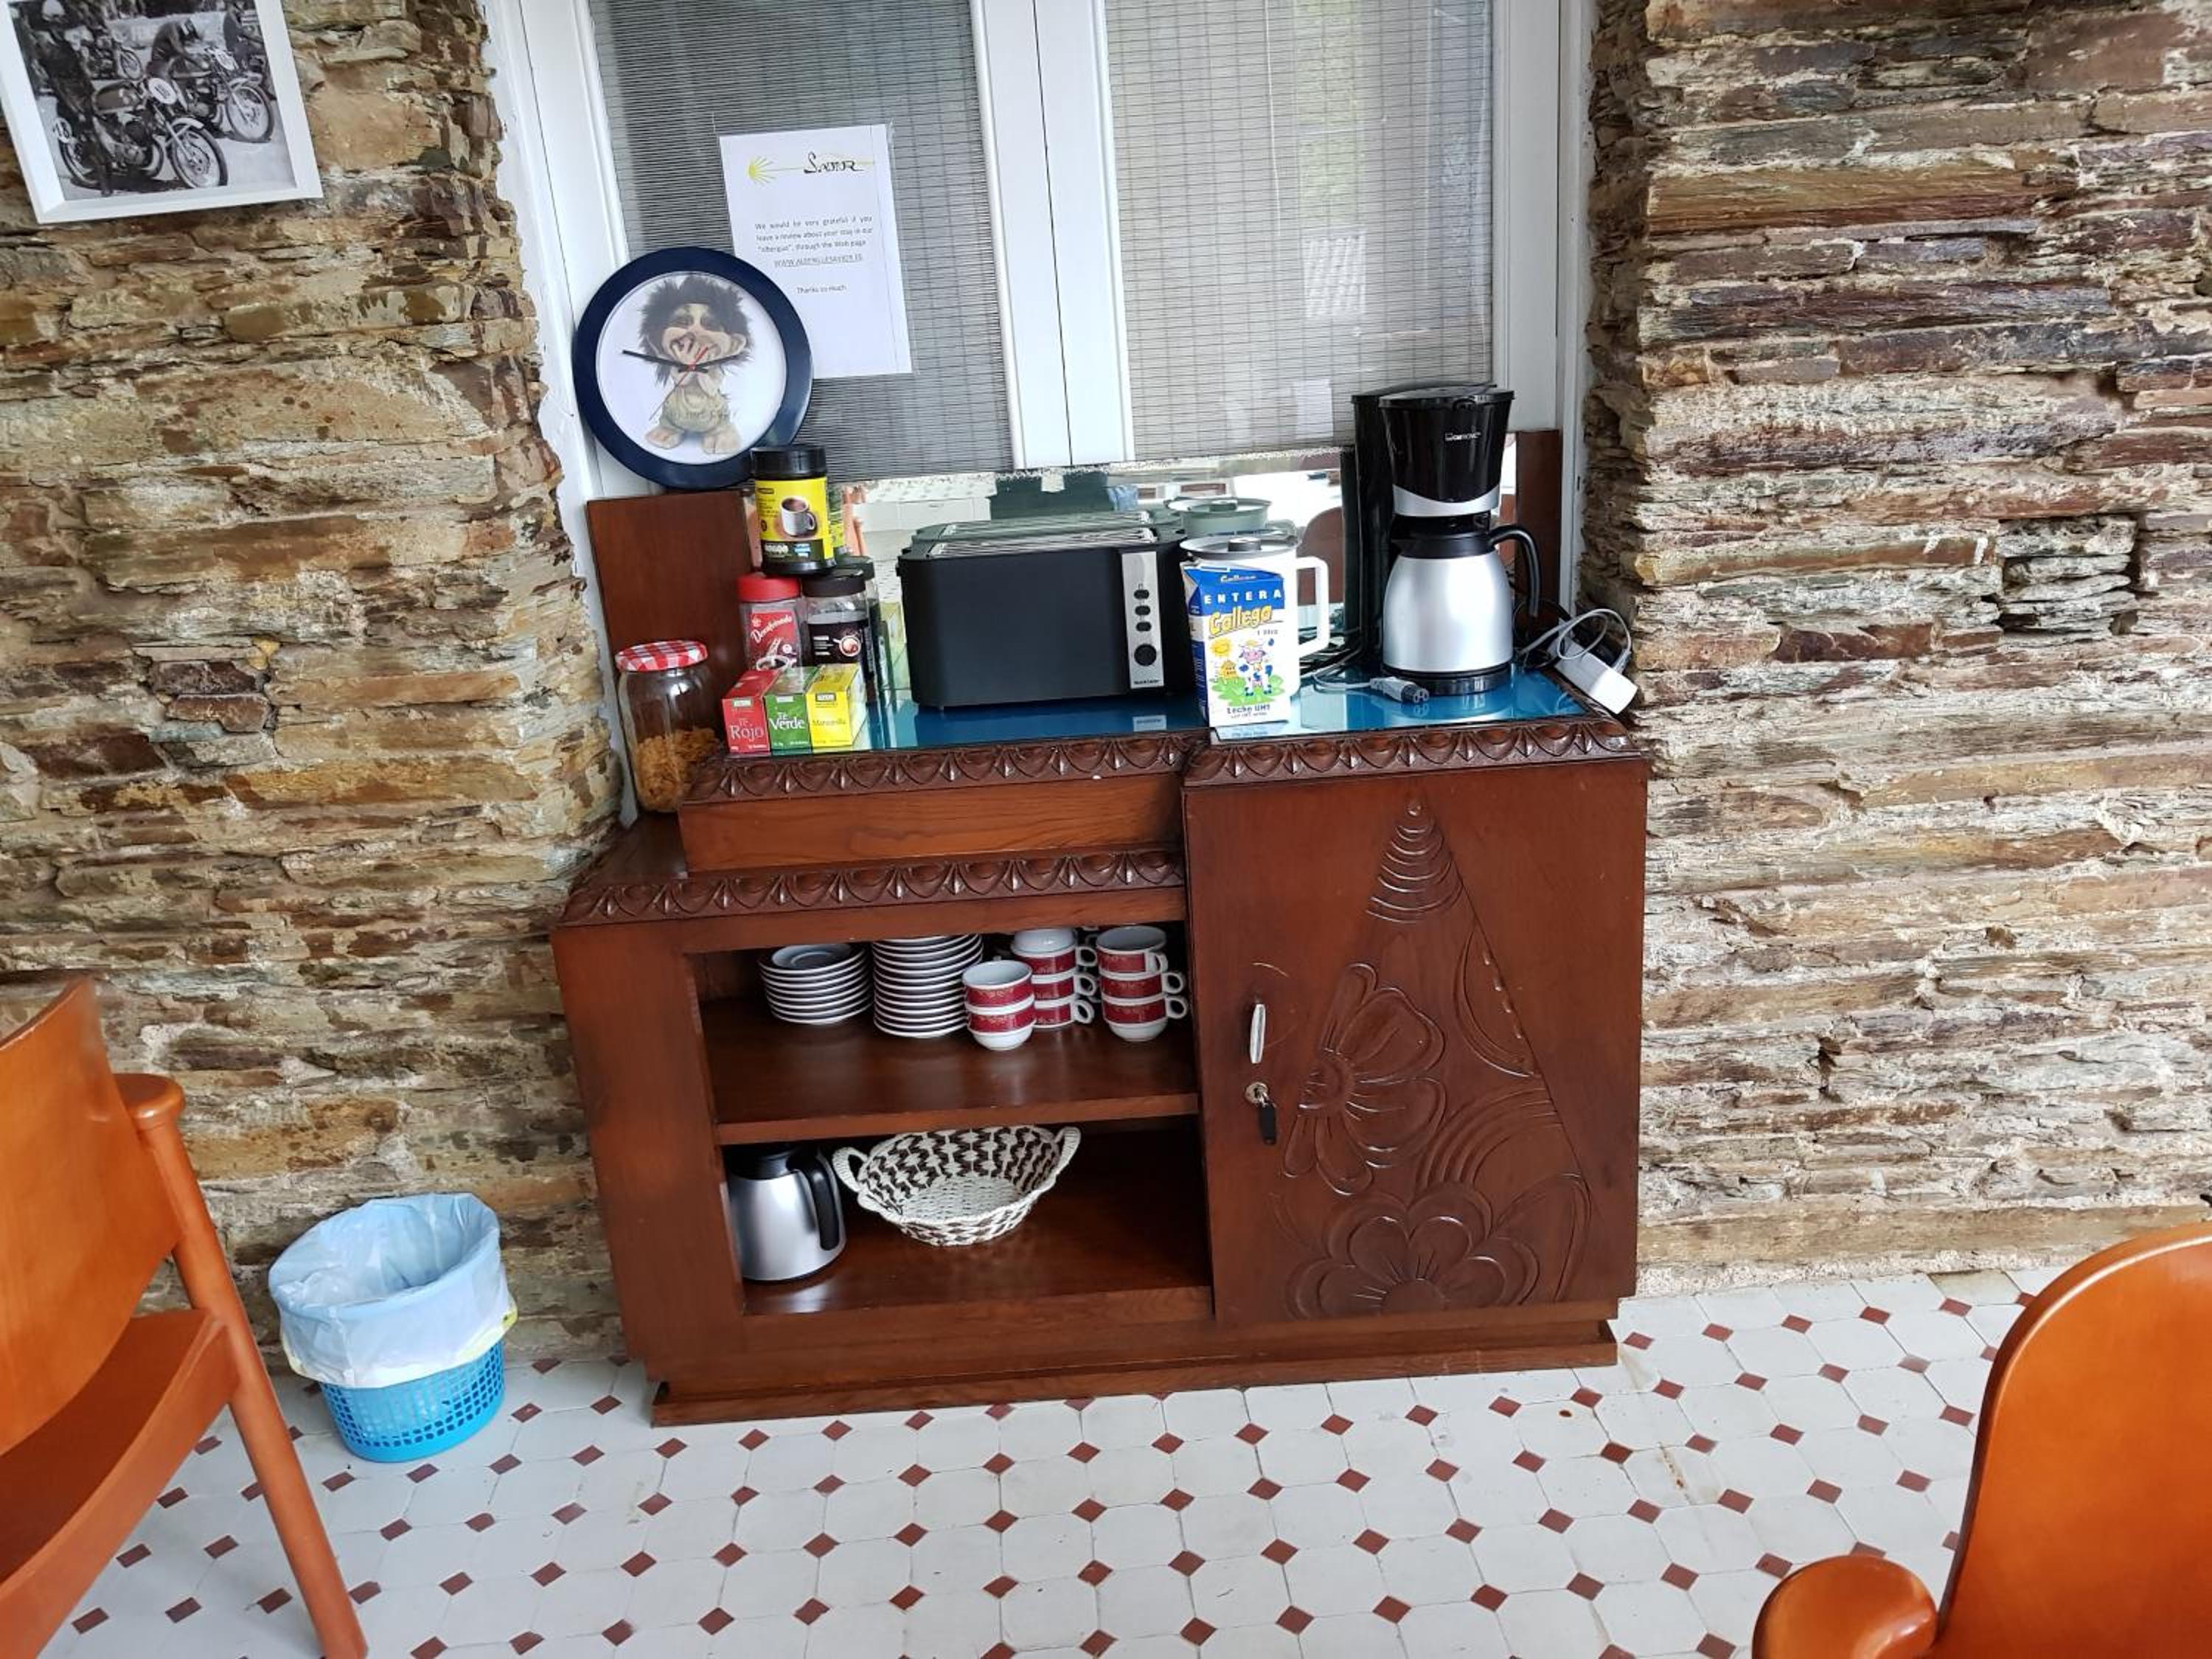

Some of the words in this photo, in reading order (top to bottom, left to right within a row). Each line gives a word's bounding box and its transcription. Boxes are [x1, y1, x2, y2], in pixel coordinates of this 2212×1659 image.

[770, 220, 790, 229] would
[1204, 589, 1282, 605] ENTERA
[768, 717, 806, 731] Verde
[730, 724, 764, 742] Rojo
